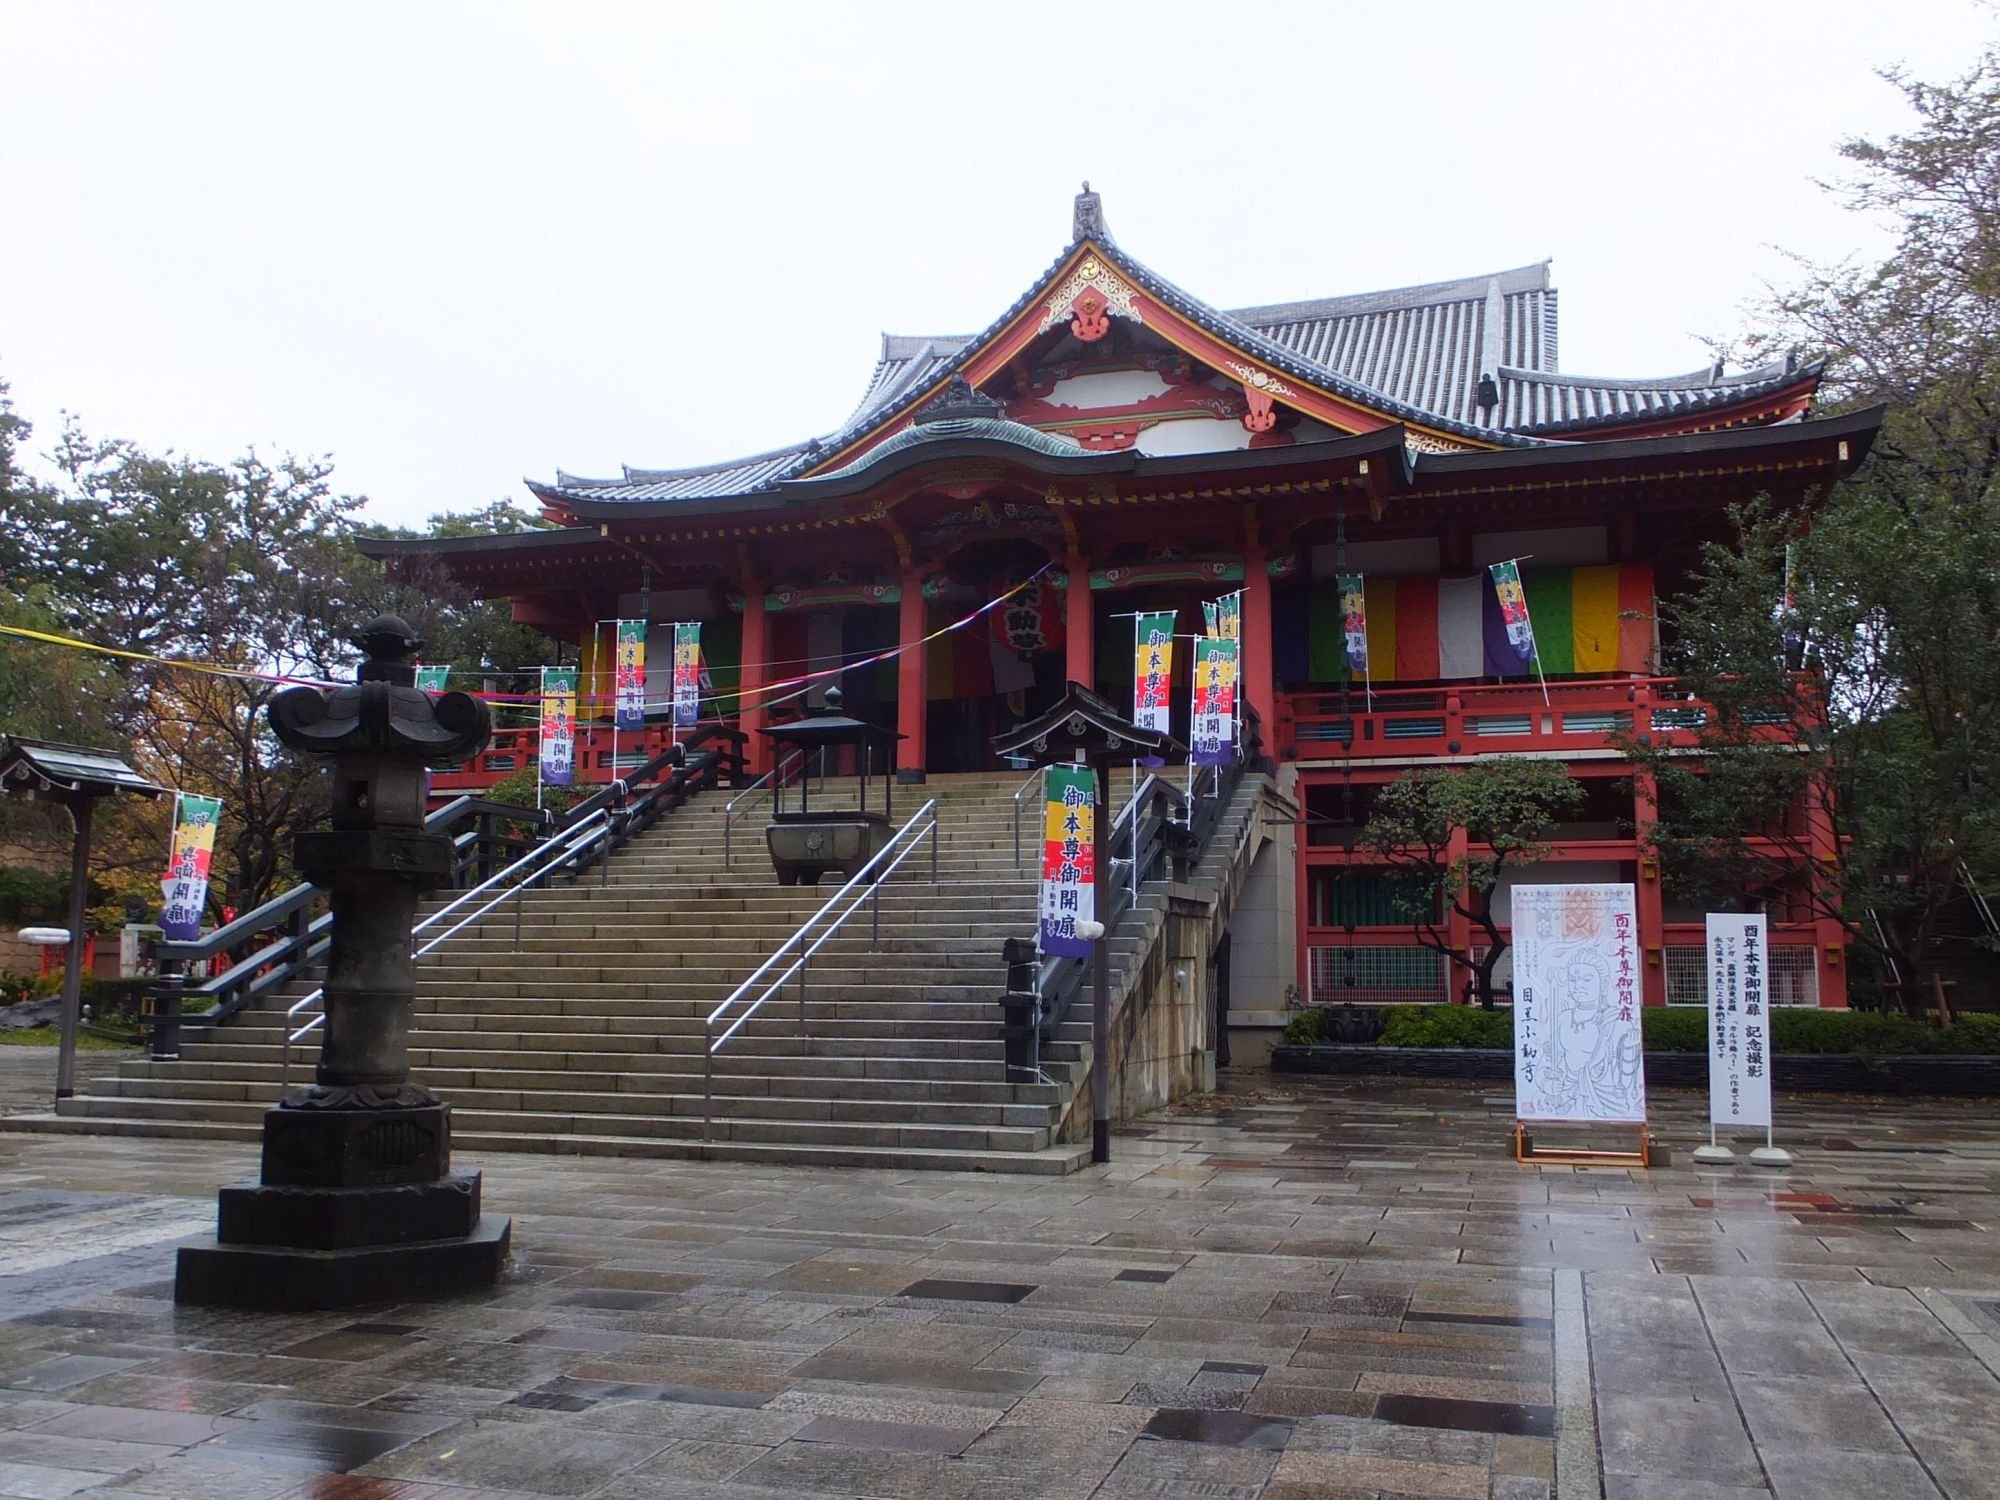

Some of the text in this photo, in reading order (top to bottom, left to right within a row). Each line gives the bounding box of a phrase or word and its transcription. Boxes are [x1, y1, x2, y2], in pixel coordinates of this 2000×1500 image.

[1204, 649, 1224, 753] 御本尊御開扉
[1056, 784, 1086, 940] 御本尊御開扉
[1745, 1025, 1763, 1078] 記念撮影
